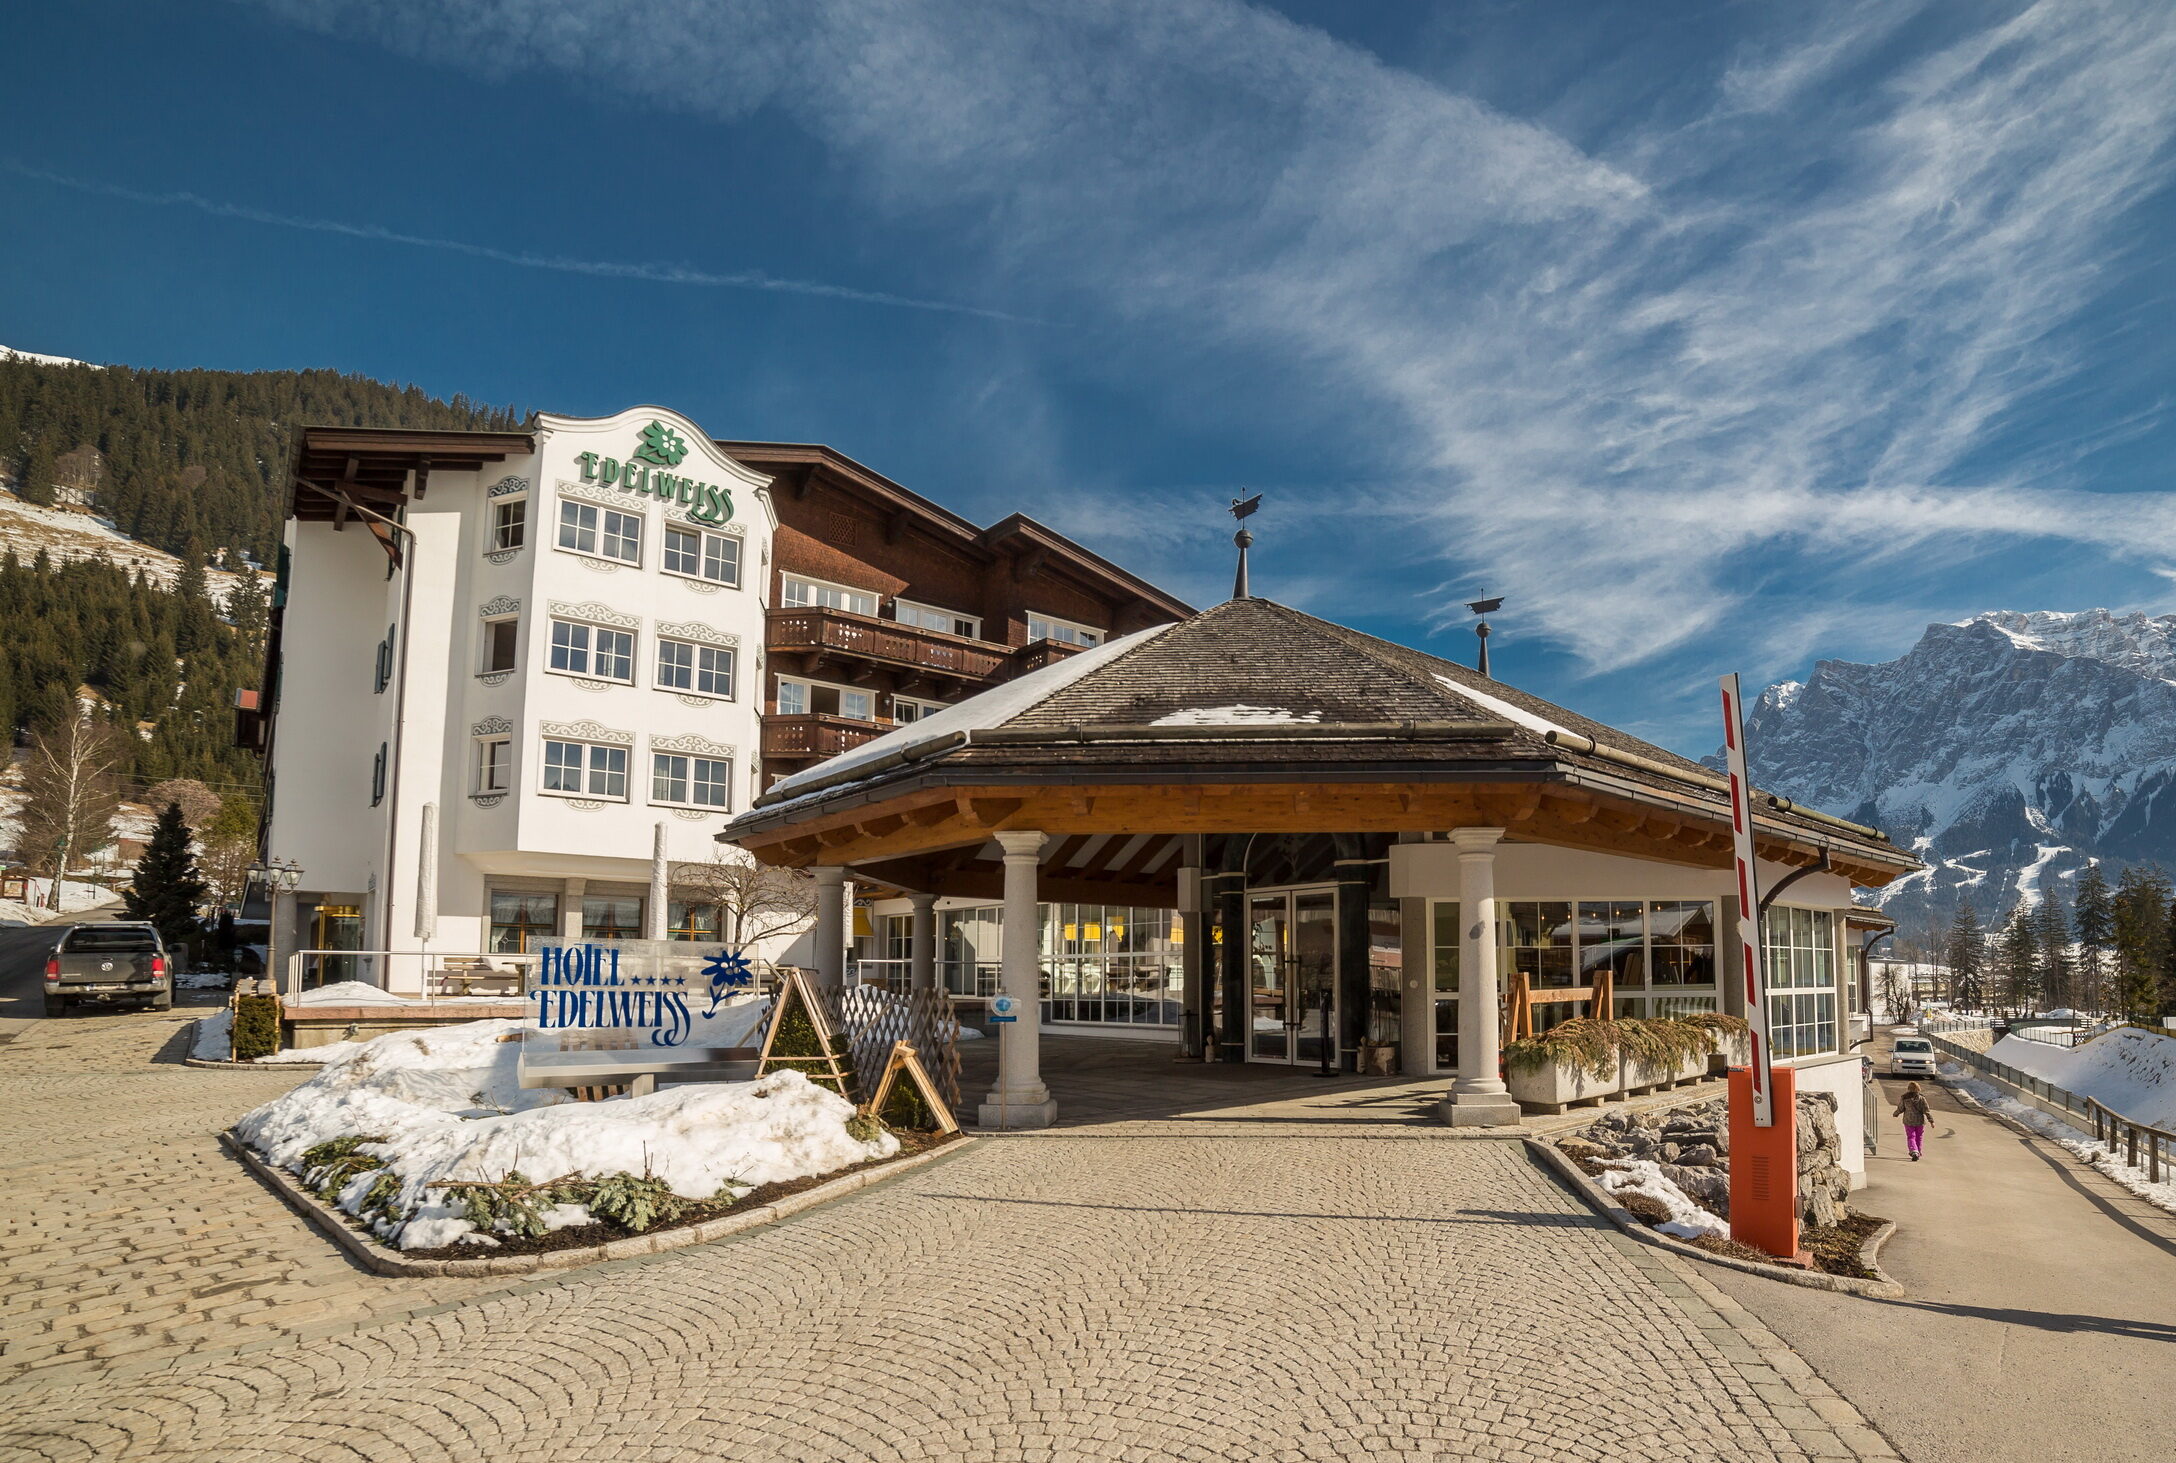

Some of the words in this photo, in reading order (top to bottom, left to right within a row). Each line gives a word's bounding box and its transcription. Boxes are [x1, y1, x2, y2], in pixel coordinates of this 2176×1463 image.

[580, 451, 735, 525] EDELWEISS
[540, 943, 625, 986] HOTEL
[529, 990, 691, 1047] EDELWEISS
